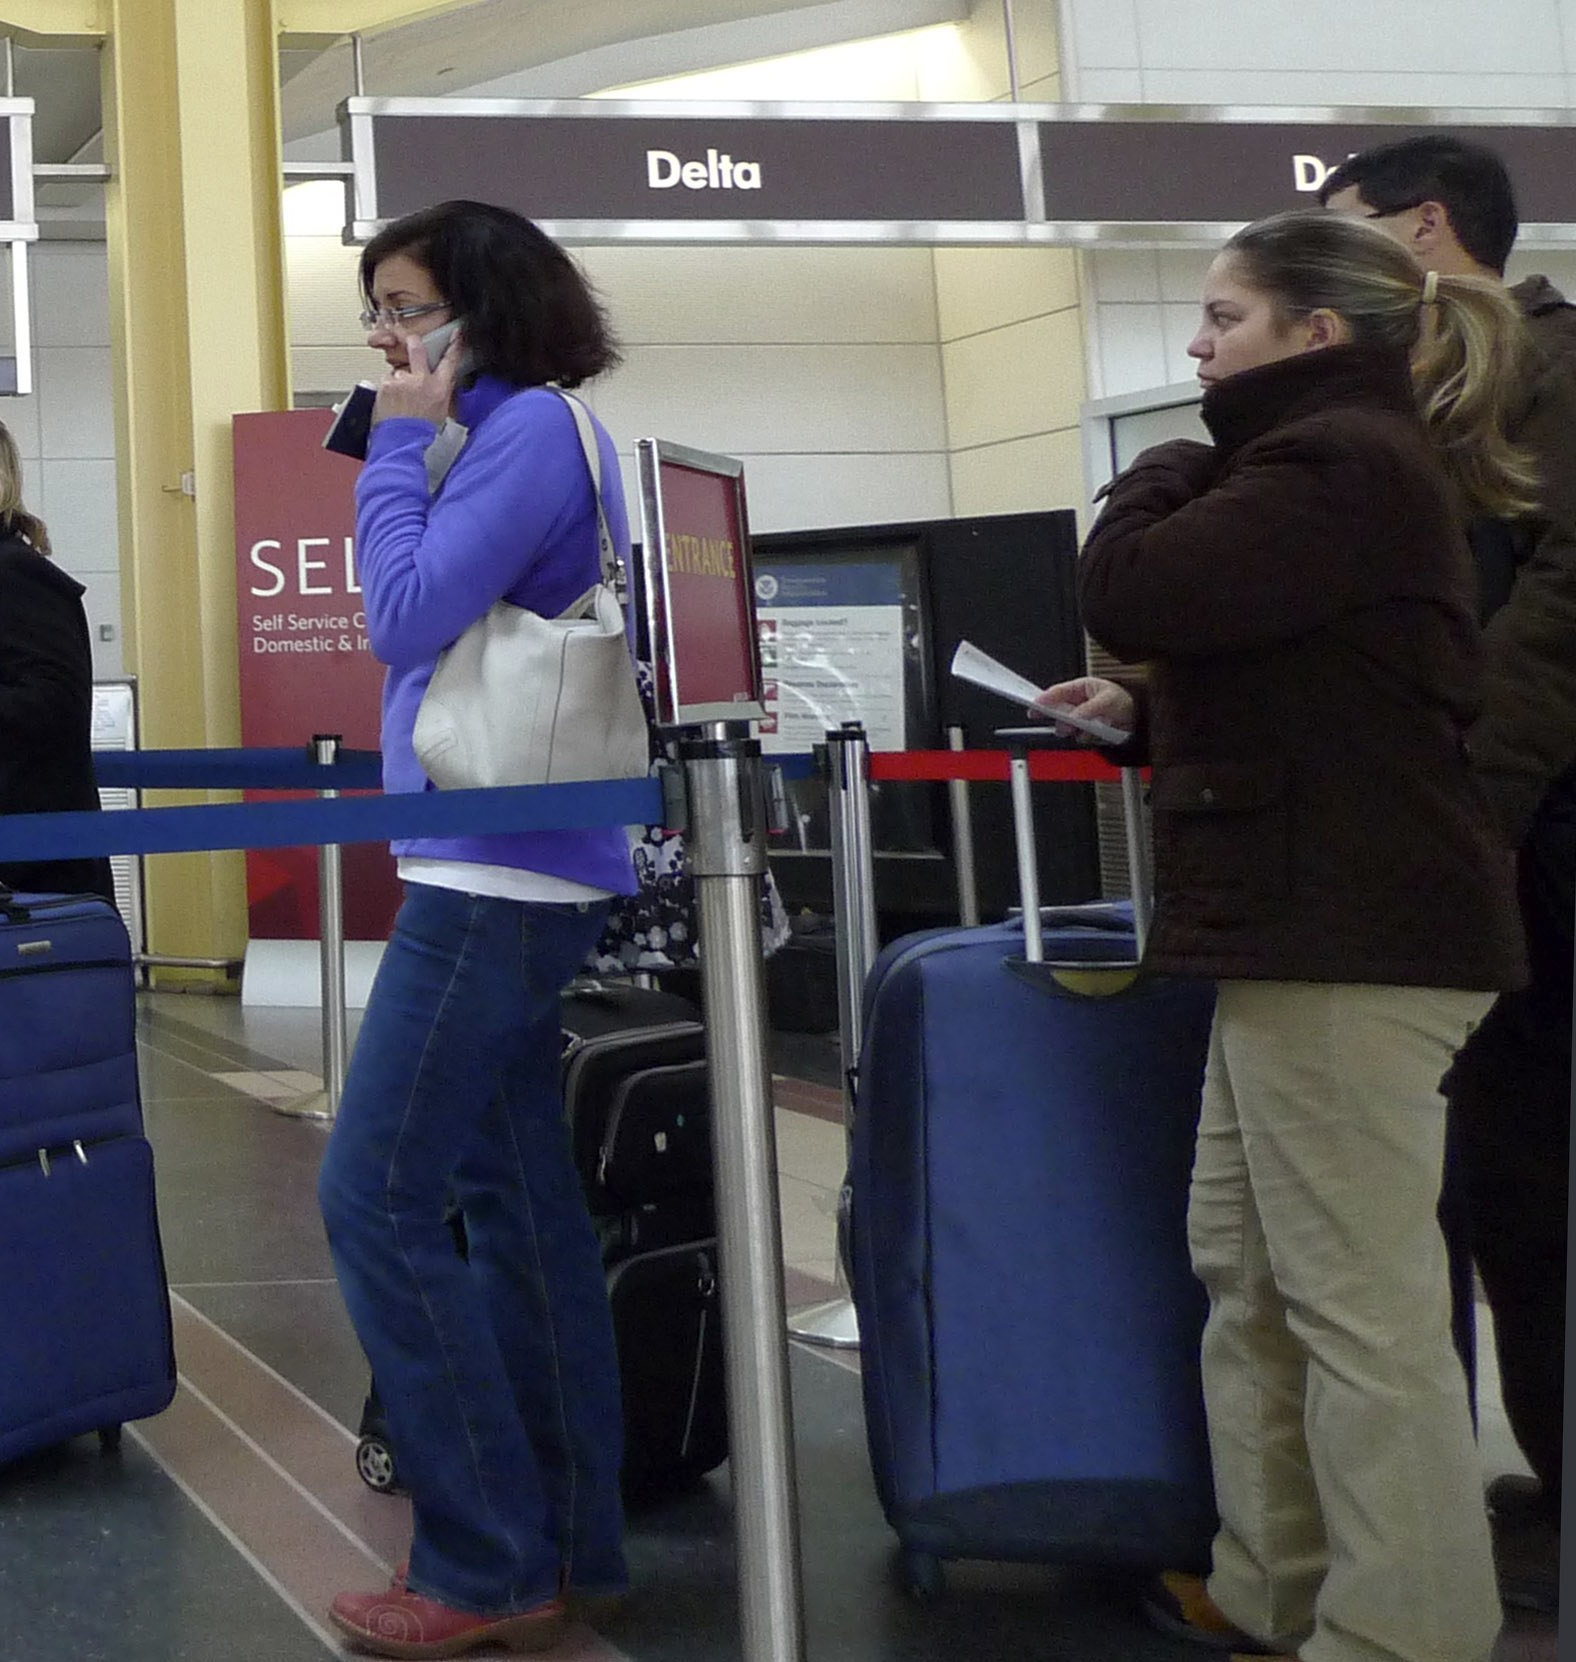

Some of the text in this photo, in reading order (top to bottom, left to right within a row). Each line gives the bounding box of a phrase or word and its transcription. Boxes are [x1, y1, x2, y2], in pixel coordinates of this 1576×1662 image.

[646, 148, 762, 189] Delta
[250, 537, 362, 597] SEL
[252, 614, 283, 631] Self
[287, 613, 349, 630] Service
[253, 636, 334, 653] Domestic
[337, 634, 353, 651] &
